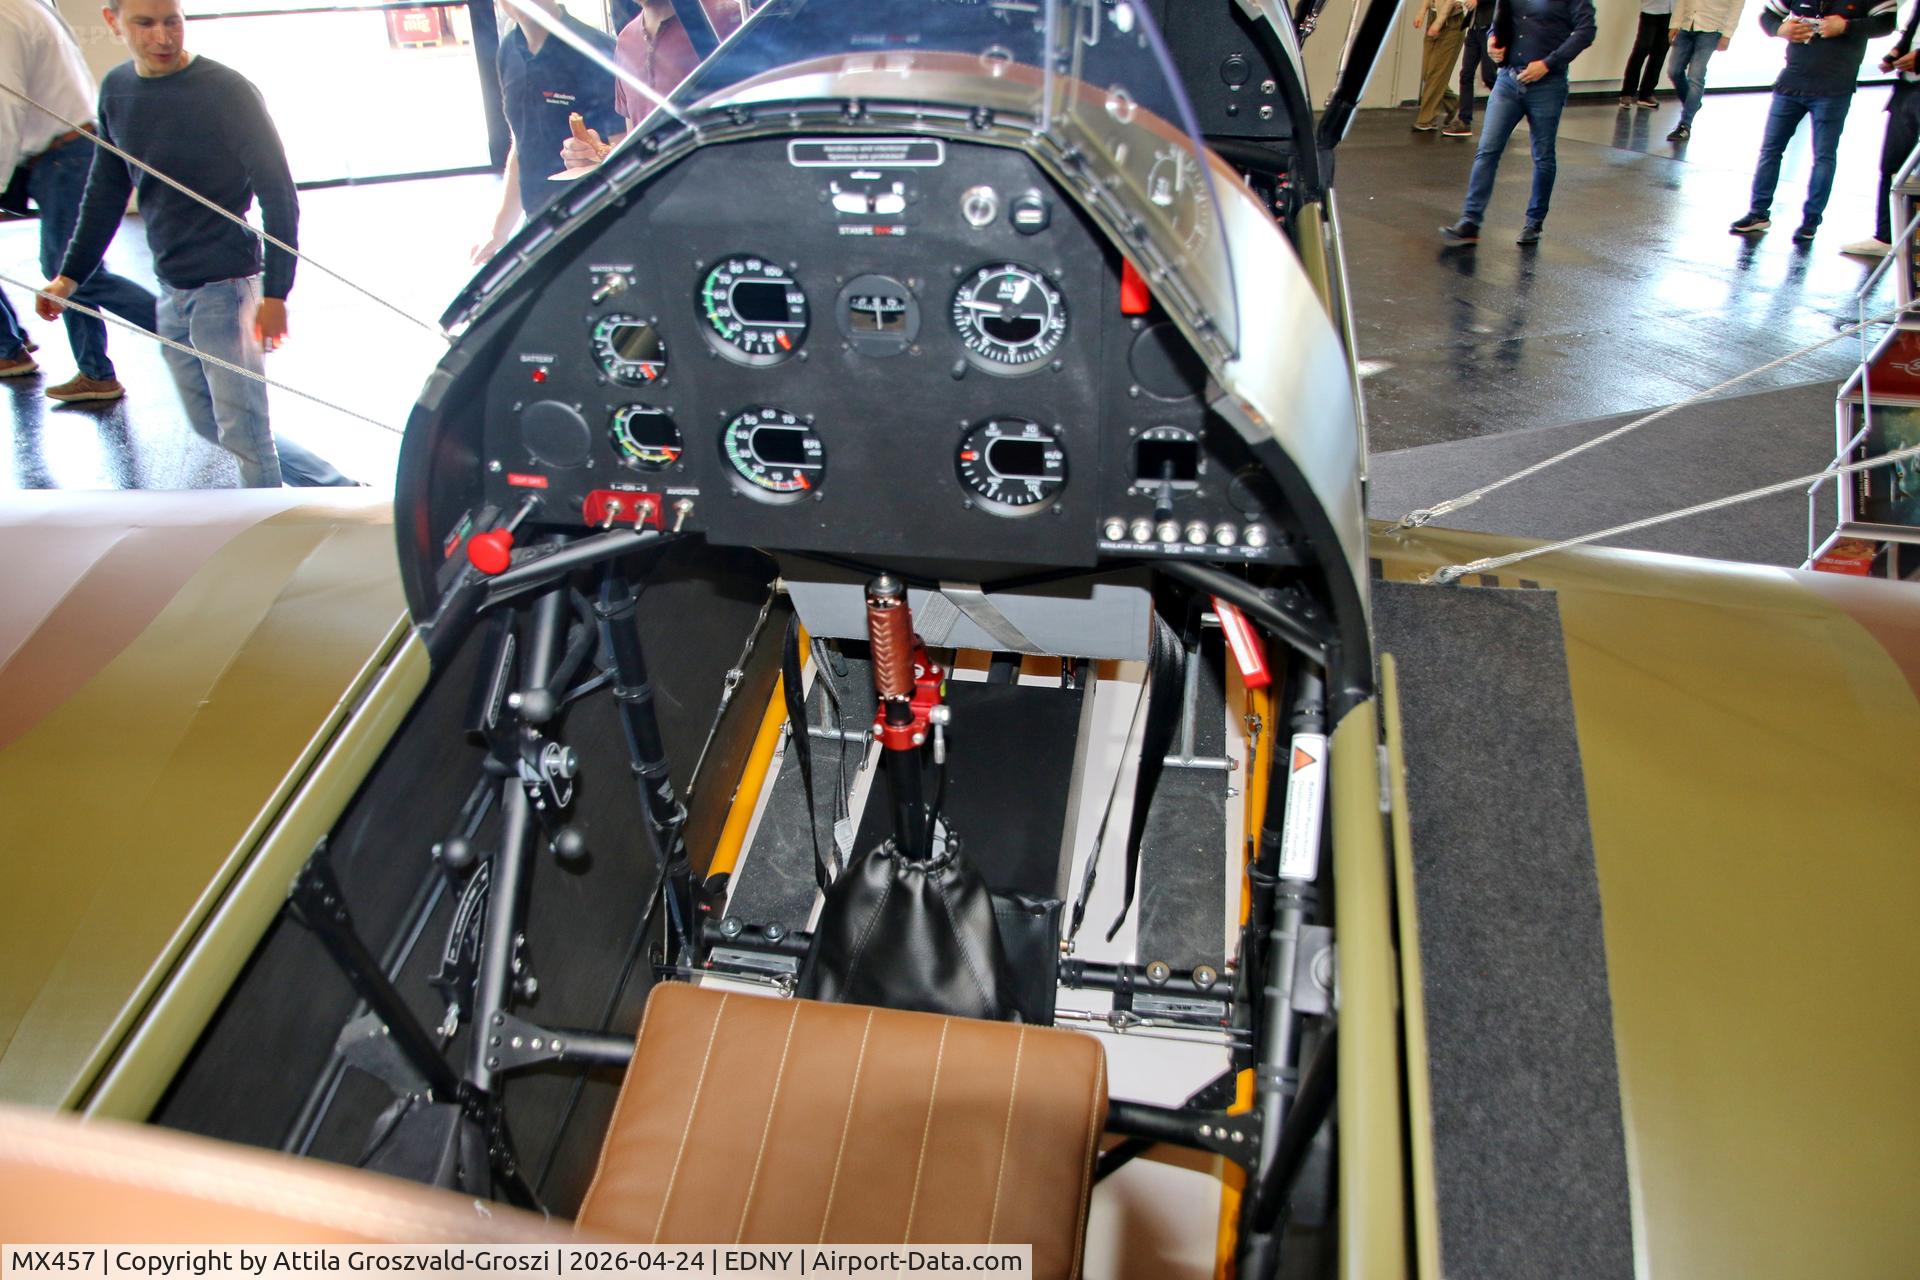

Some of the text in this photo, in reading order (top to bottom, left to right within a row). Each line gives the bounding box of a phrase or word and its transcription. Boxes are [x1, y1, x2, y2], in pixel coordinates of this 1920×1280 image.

[838, 225, 873, 236] STAMPE
[746, 260, 761, 271] 90
[713, 290, 727, 300] 60
[786, 292, 805, 304] IAS
[717, 306, 731, 317] 50
[520, 354, 554, 363] BATTERY
[743, 413, 758, 425] 50
[762, 409, 776, 419] 60
[781, 414, 796, 425] 70
[771, 471, 783, 481] 10
[1285, 780, 1295, 826] Emergency
